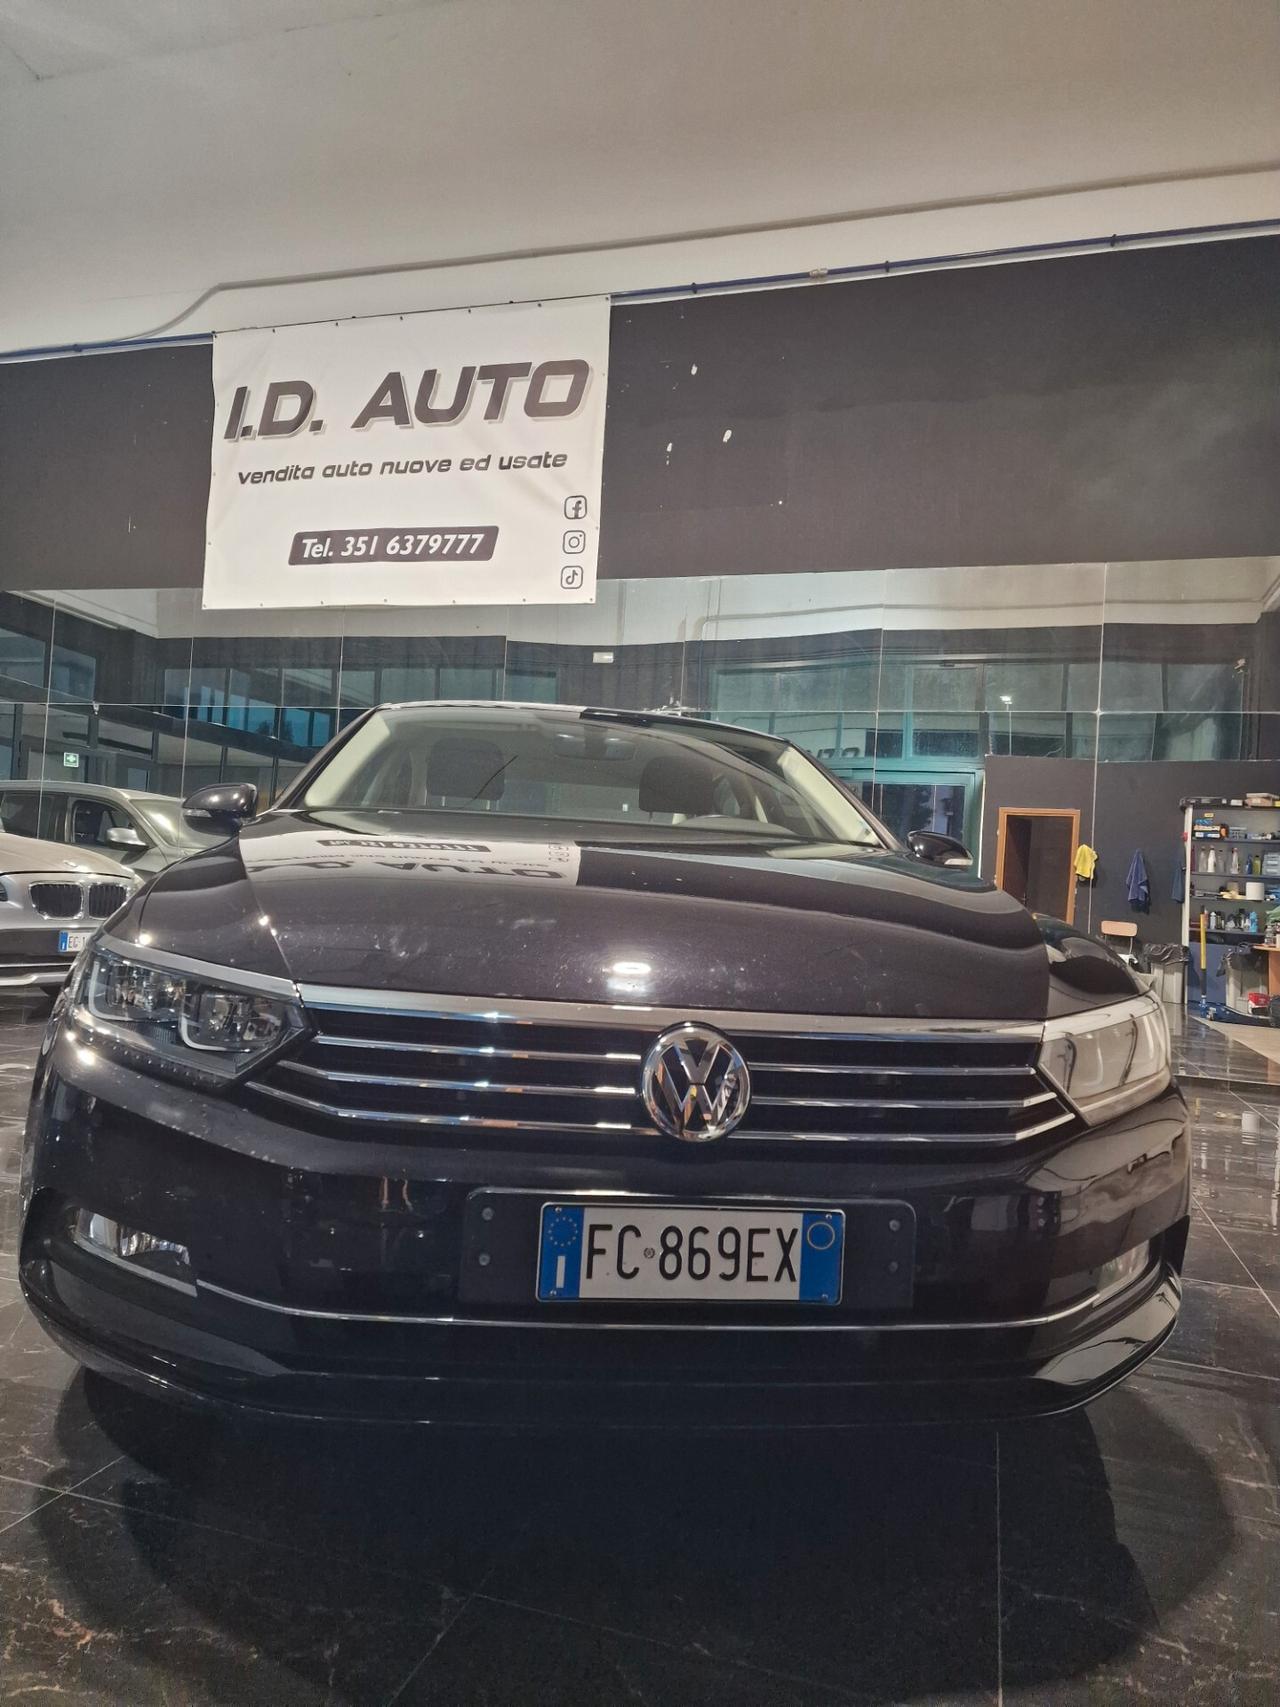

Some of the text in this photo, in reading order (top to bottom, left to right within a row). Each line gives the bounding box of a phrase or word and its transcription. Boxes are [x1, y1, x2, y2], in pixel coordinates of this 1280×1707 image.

[224, 360, 591, 441] I.D. AUTO
[238, 451, 567, 484] vendita auto nuove ed usate
[302, 533, 485, 558] Tel. 351 6379777
[585, 1224, 799, 1283] FC 869EX
